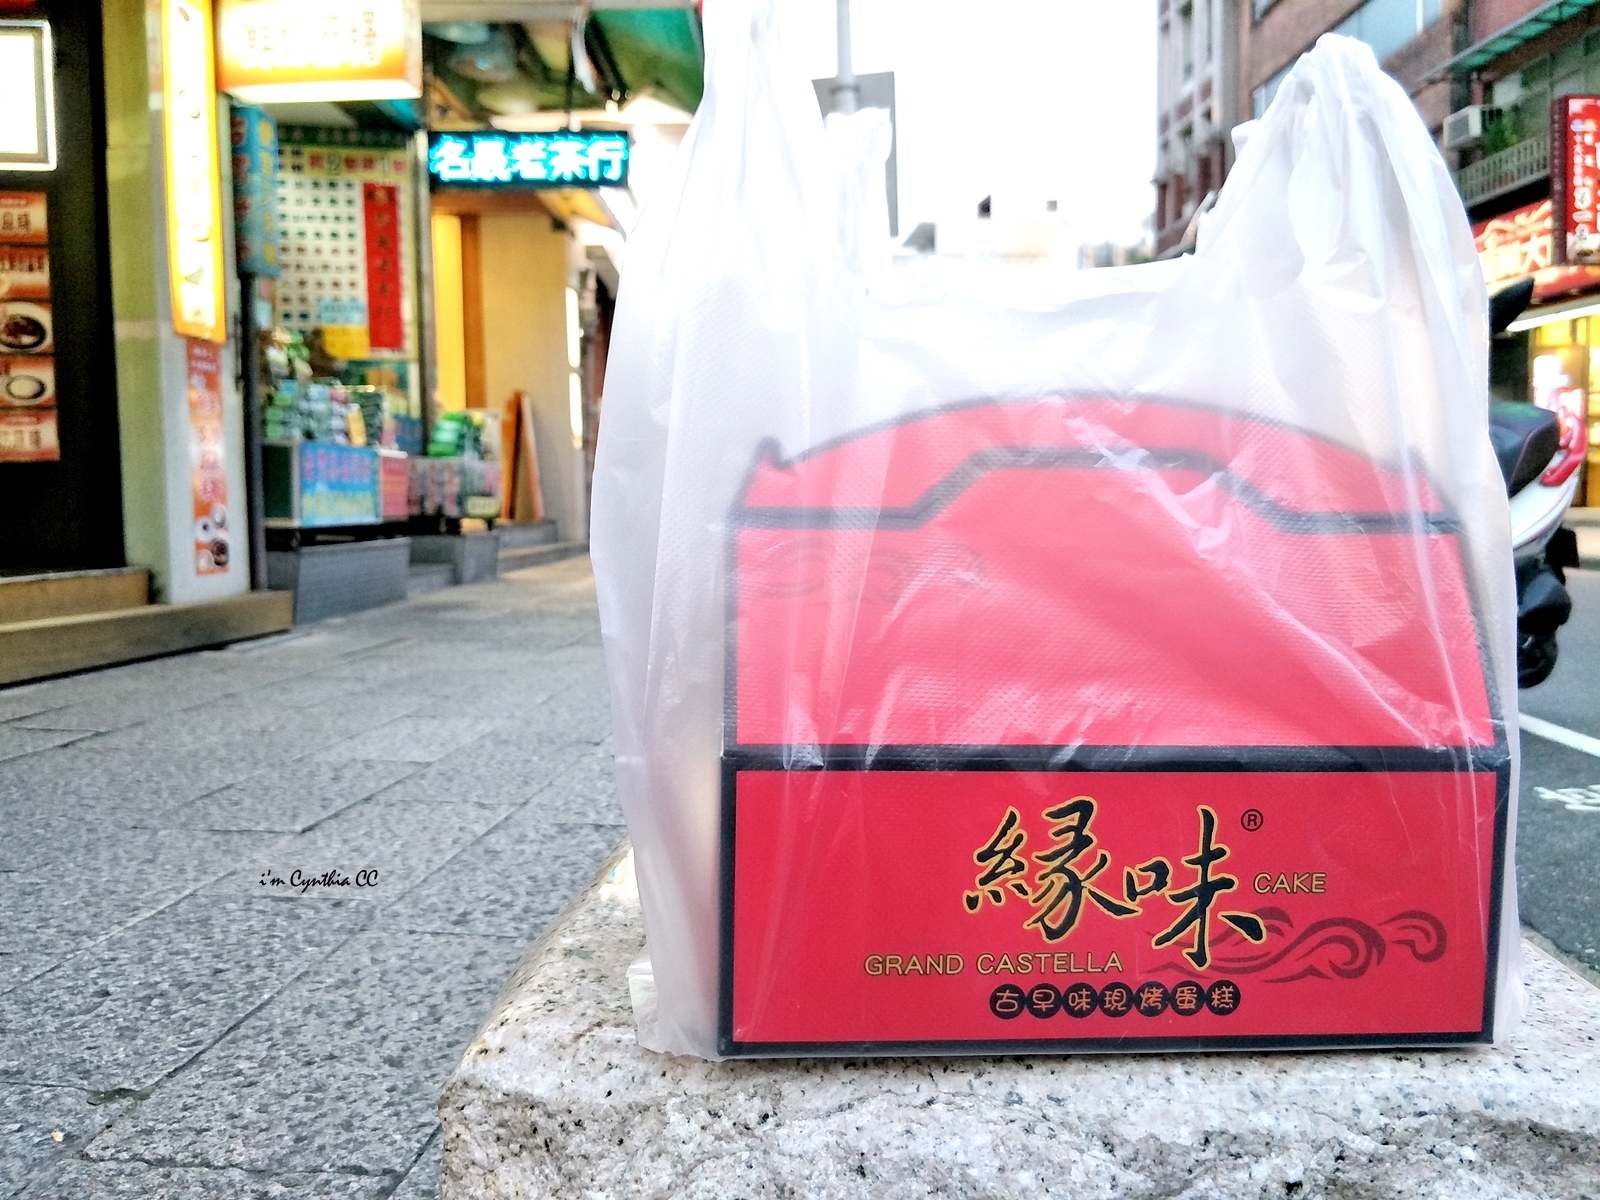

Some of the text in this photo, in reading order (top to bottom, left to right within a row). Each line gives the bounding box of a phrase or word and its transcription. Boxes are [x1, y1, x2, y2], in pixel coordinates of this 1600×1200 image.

[1253, 871, 1327, 895] CAKE
[864, 951, 1125, 976] GRAND CASTELLA
[994, 984, 1237, 1014] 古早味現烤蛋糕
